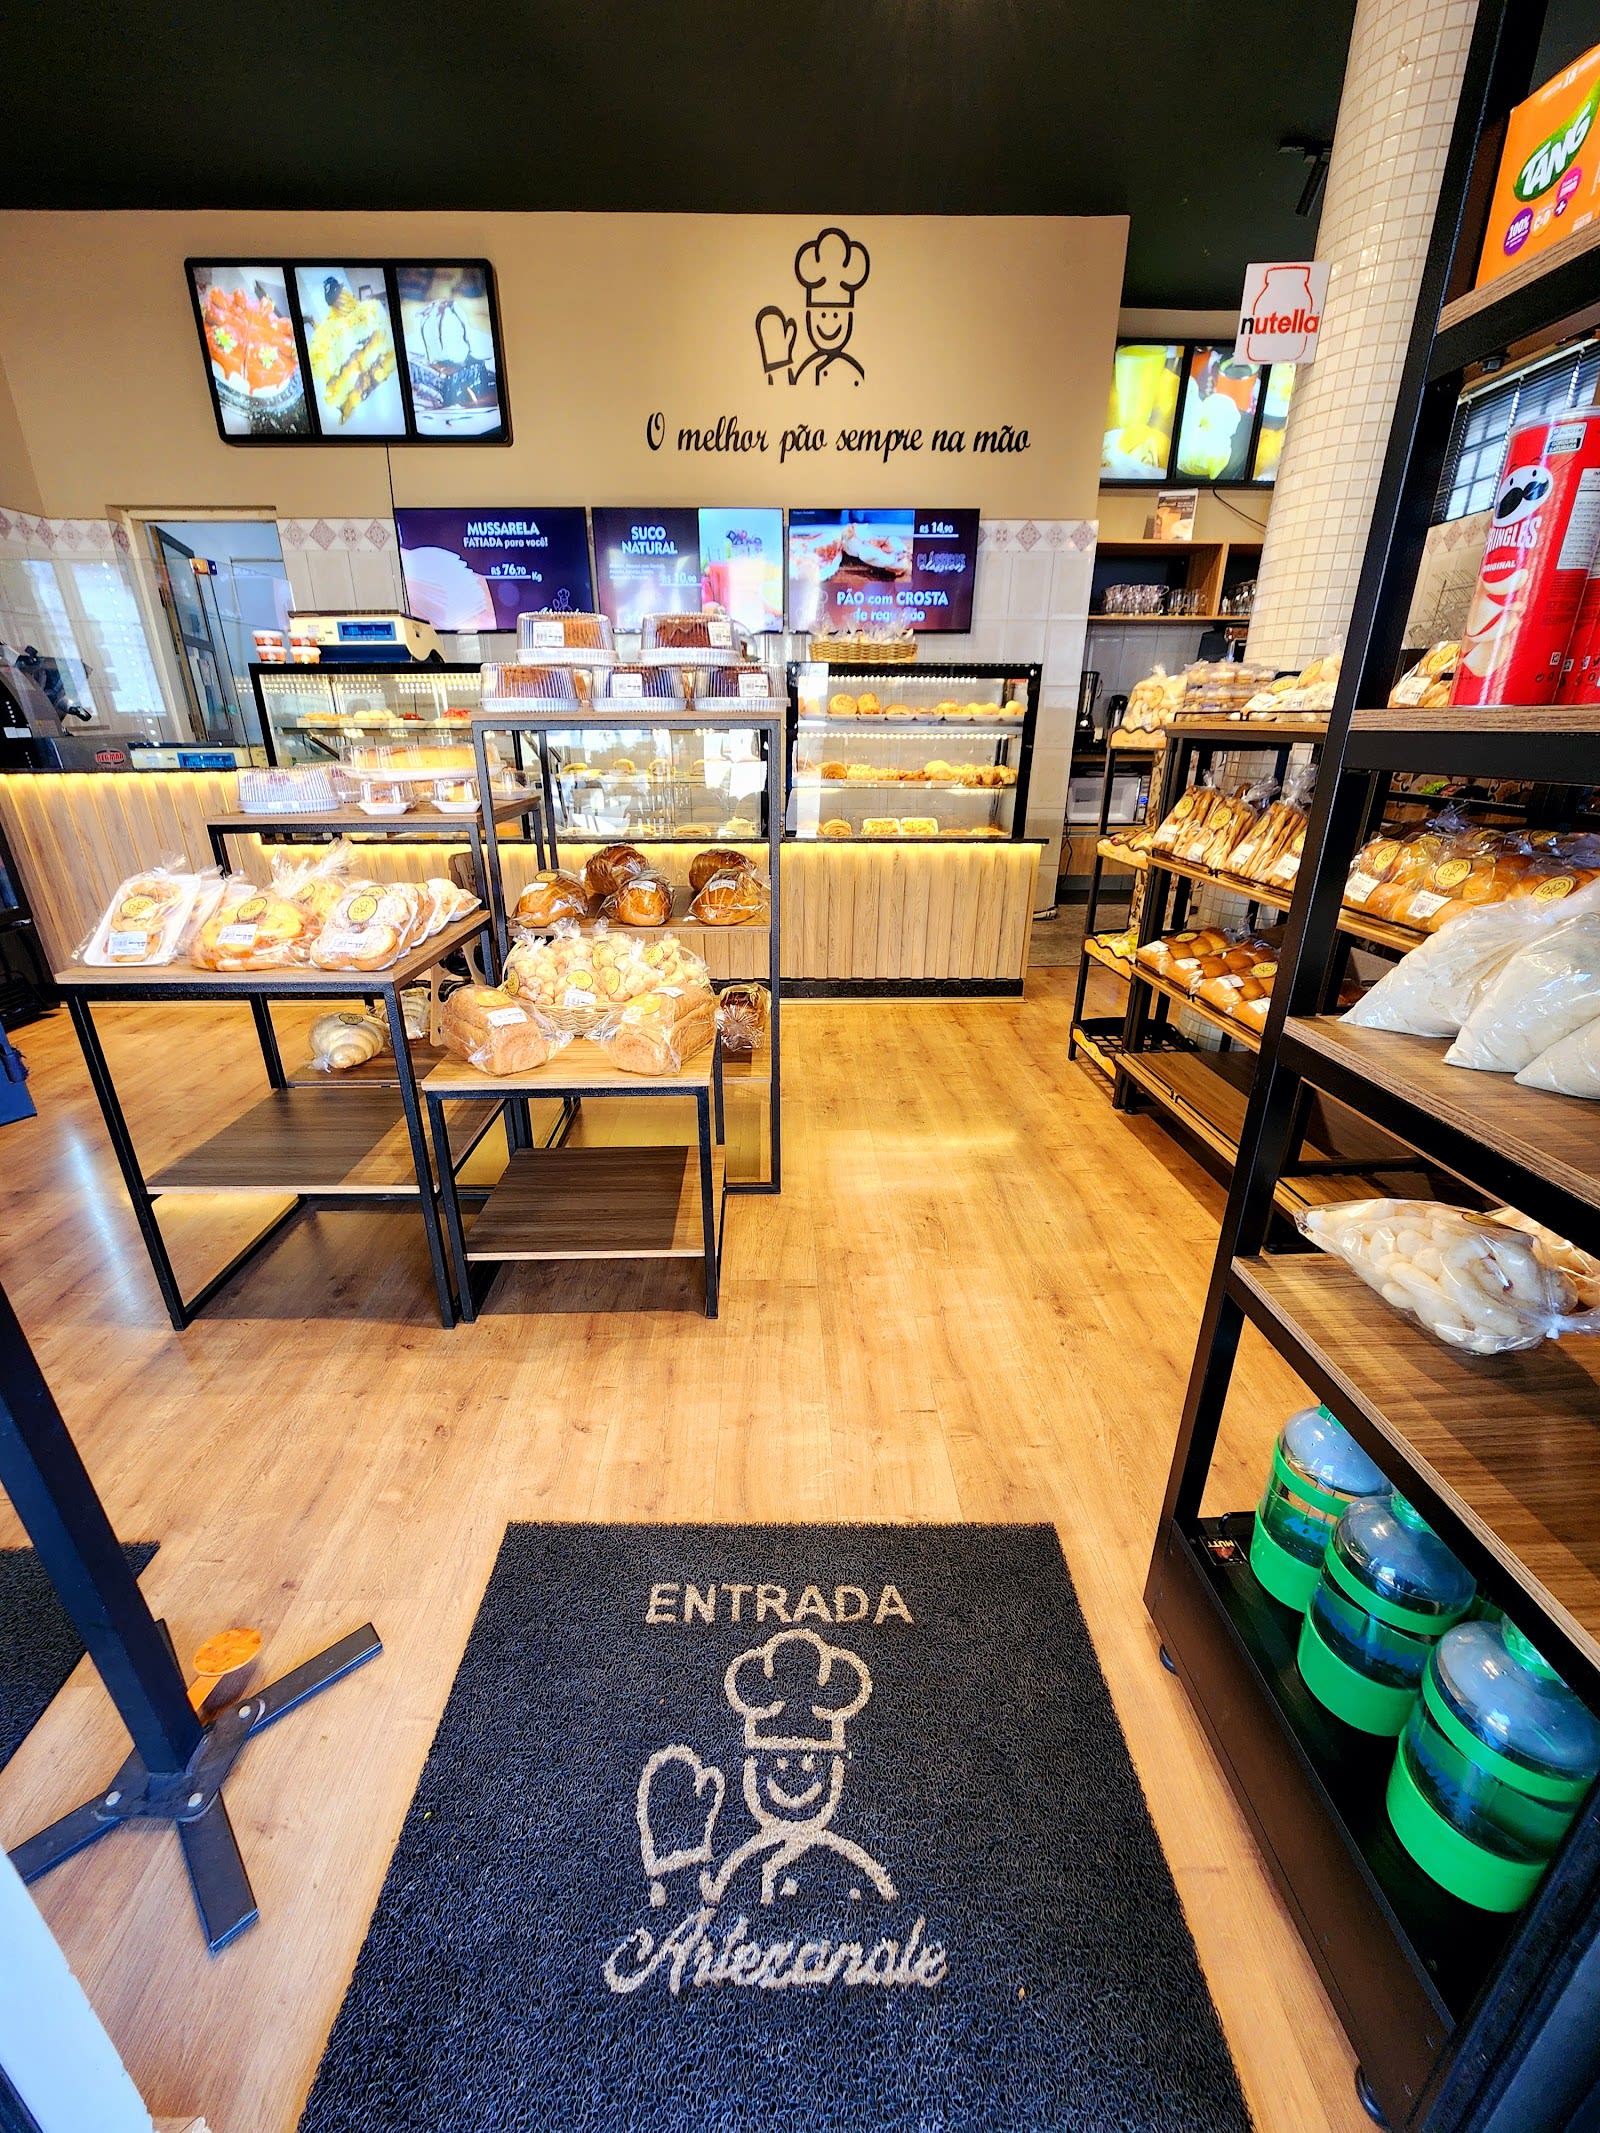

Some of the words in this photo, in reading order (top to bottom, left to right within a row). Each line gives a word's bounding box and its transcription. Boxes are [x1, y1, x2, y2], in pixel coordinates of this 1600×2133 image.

[1521, 101, 1592, 195] TANG
[1240, 309, 1320, 335] nutella
[645, 411, 666, 451] O
[677, 415, 769, 452] melhor
[779, 424, 828, 463] pão
[835, 427, 924, 464] sempre
[931, 428, 967, 453] na
[972, 424, 1032, 453] mão
[467, 521, 540, 536] MUSSARELA
[631, 526, 667, 540] SUCO
[931, 521, 954, 534] 14,90
[1486, 515, 1542, 554] RINGLES
[463, 537, 503, 548] FATIADA
[504, 540, 525, 549] para
[621, 540, 678, 555] NATURAL
[502, 563, 527, 577] 76,70
[531, 571, 543, 582] Kg
[836, 588, 865, 606] PÃO
[868, 594, 893, 605] com
[896, 591, 949, 606] CROSTA
[644, 1582, 915, 1625] ENTRADA
